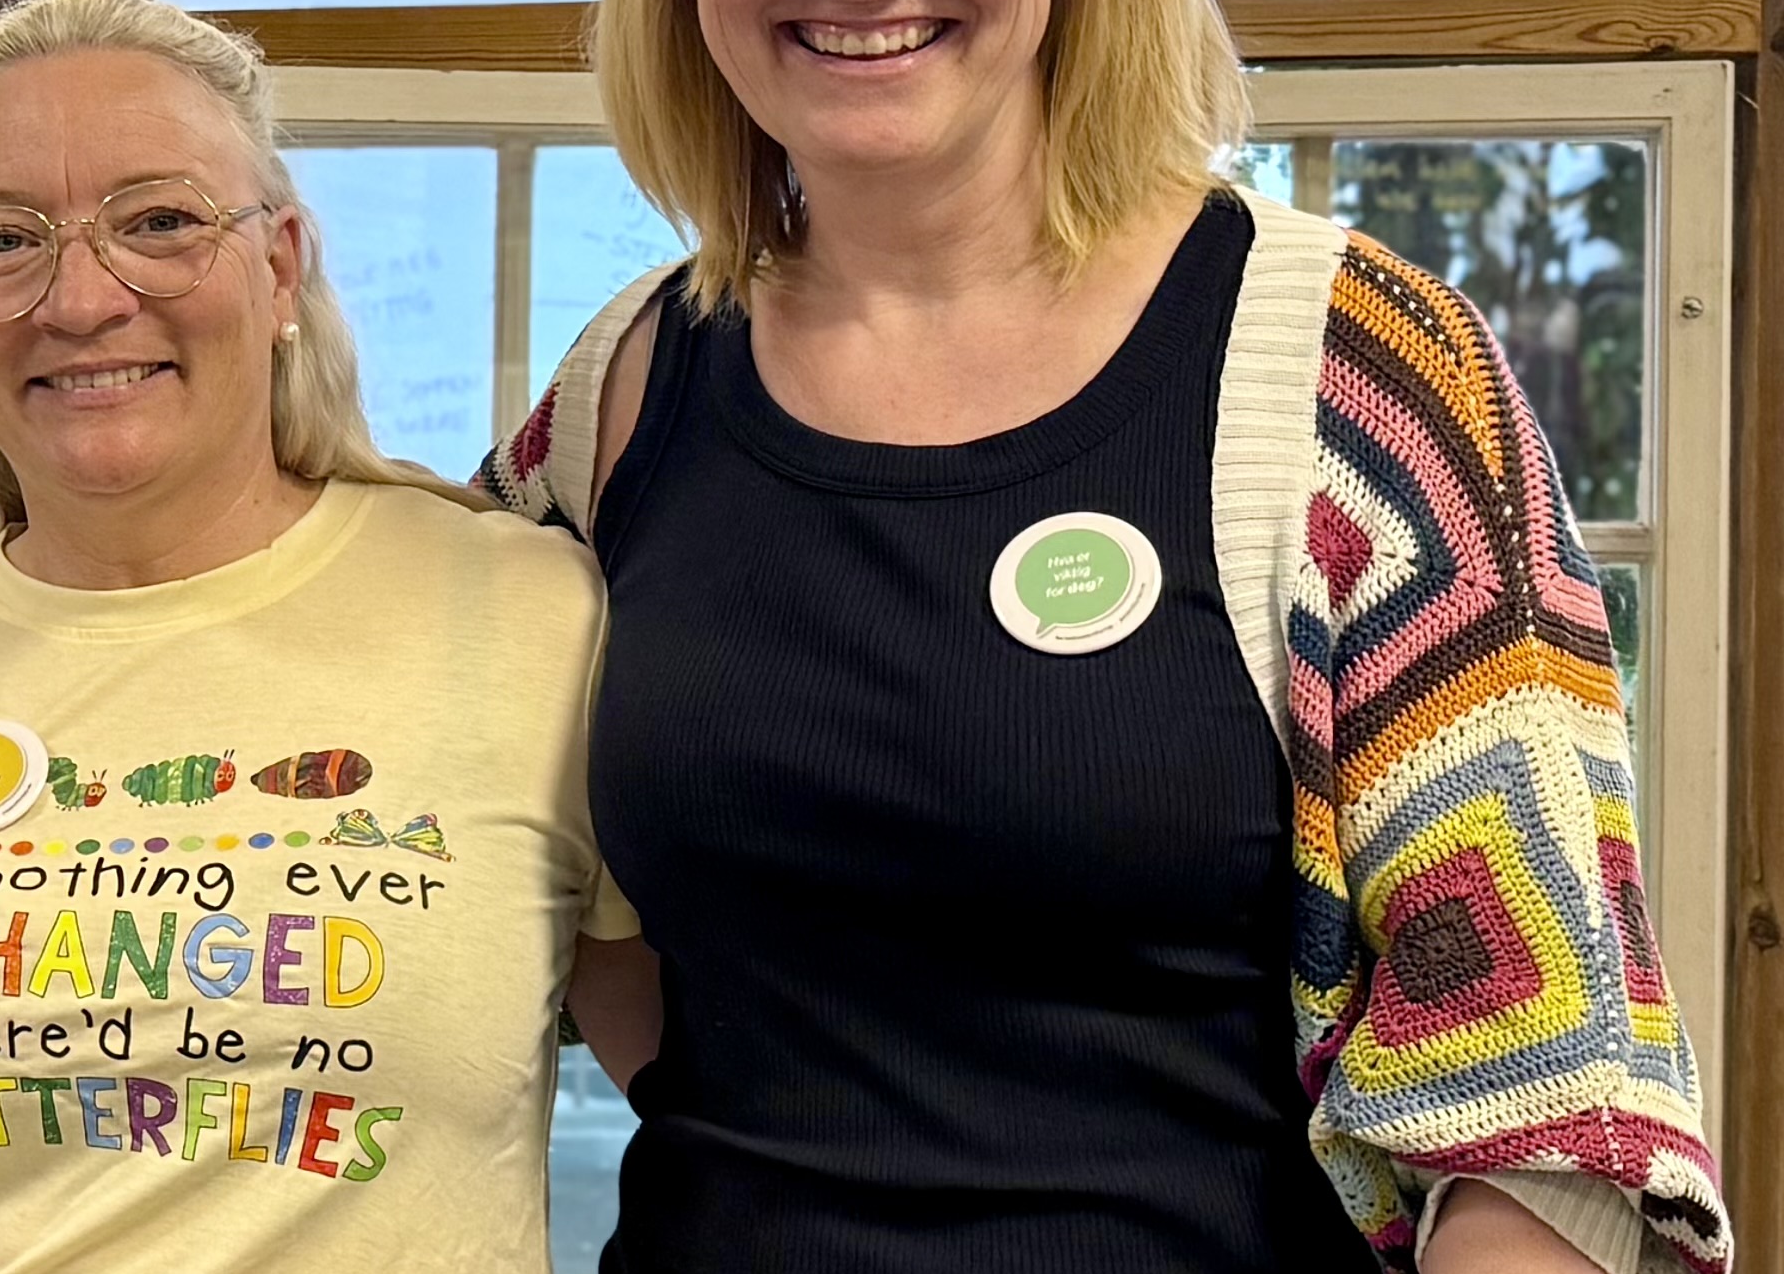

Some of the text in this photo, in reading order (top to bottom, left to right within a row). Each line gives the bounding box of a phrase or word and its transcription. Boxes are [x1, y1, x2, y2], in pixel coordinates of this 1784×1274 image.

[286, 862, 448, 910] ever
[176, 1006, 247, 1063] be
[291, 1034, 374, 1072] no
